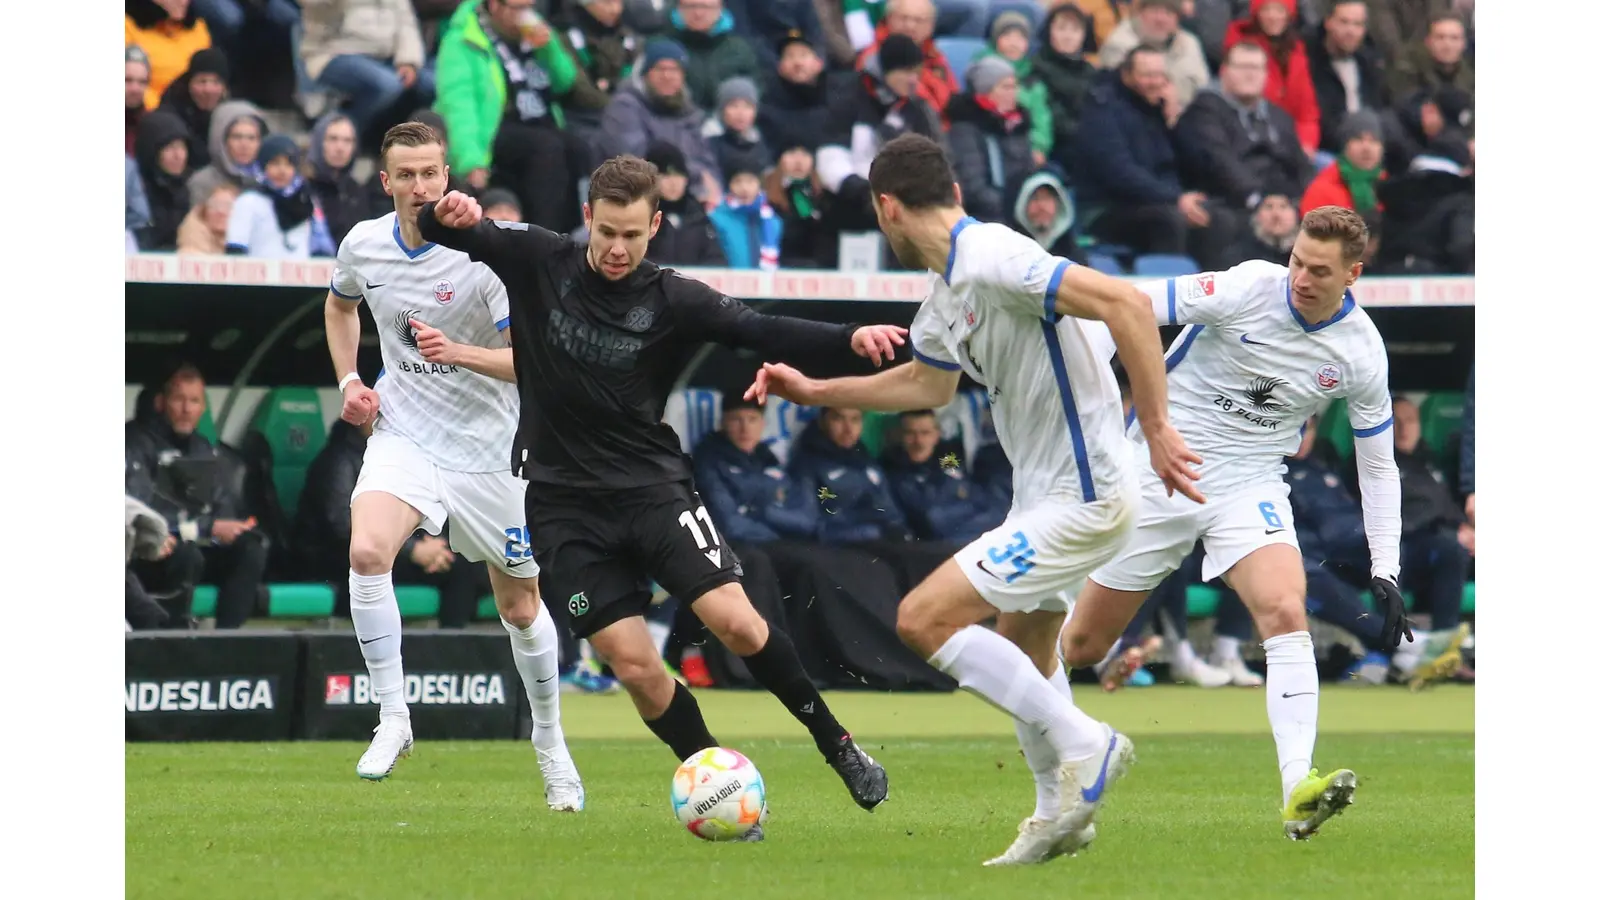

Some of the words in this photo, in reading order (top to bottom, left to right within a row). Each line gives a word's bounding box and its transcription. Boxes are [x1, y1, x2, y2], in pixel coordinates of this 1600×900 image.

[413, 363, 459, 375] BLACK
[1213, 394, 1233, 412] 28
[1235, 408, 1282, 430] BLACK
[678, 505, 720, 550] 11
[1258, 501, 1284, 529] 6
[988, 530, 1037, 583] 34
[569, 593, 590, 616] 96
[354, 675, 504, 705] BDESLIGA
[694, 779, 742, 815] DERBYSTAR
